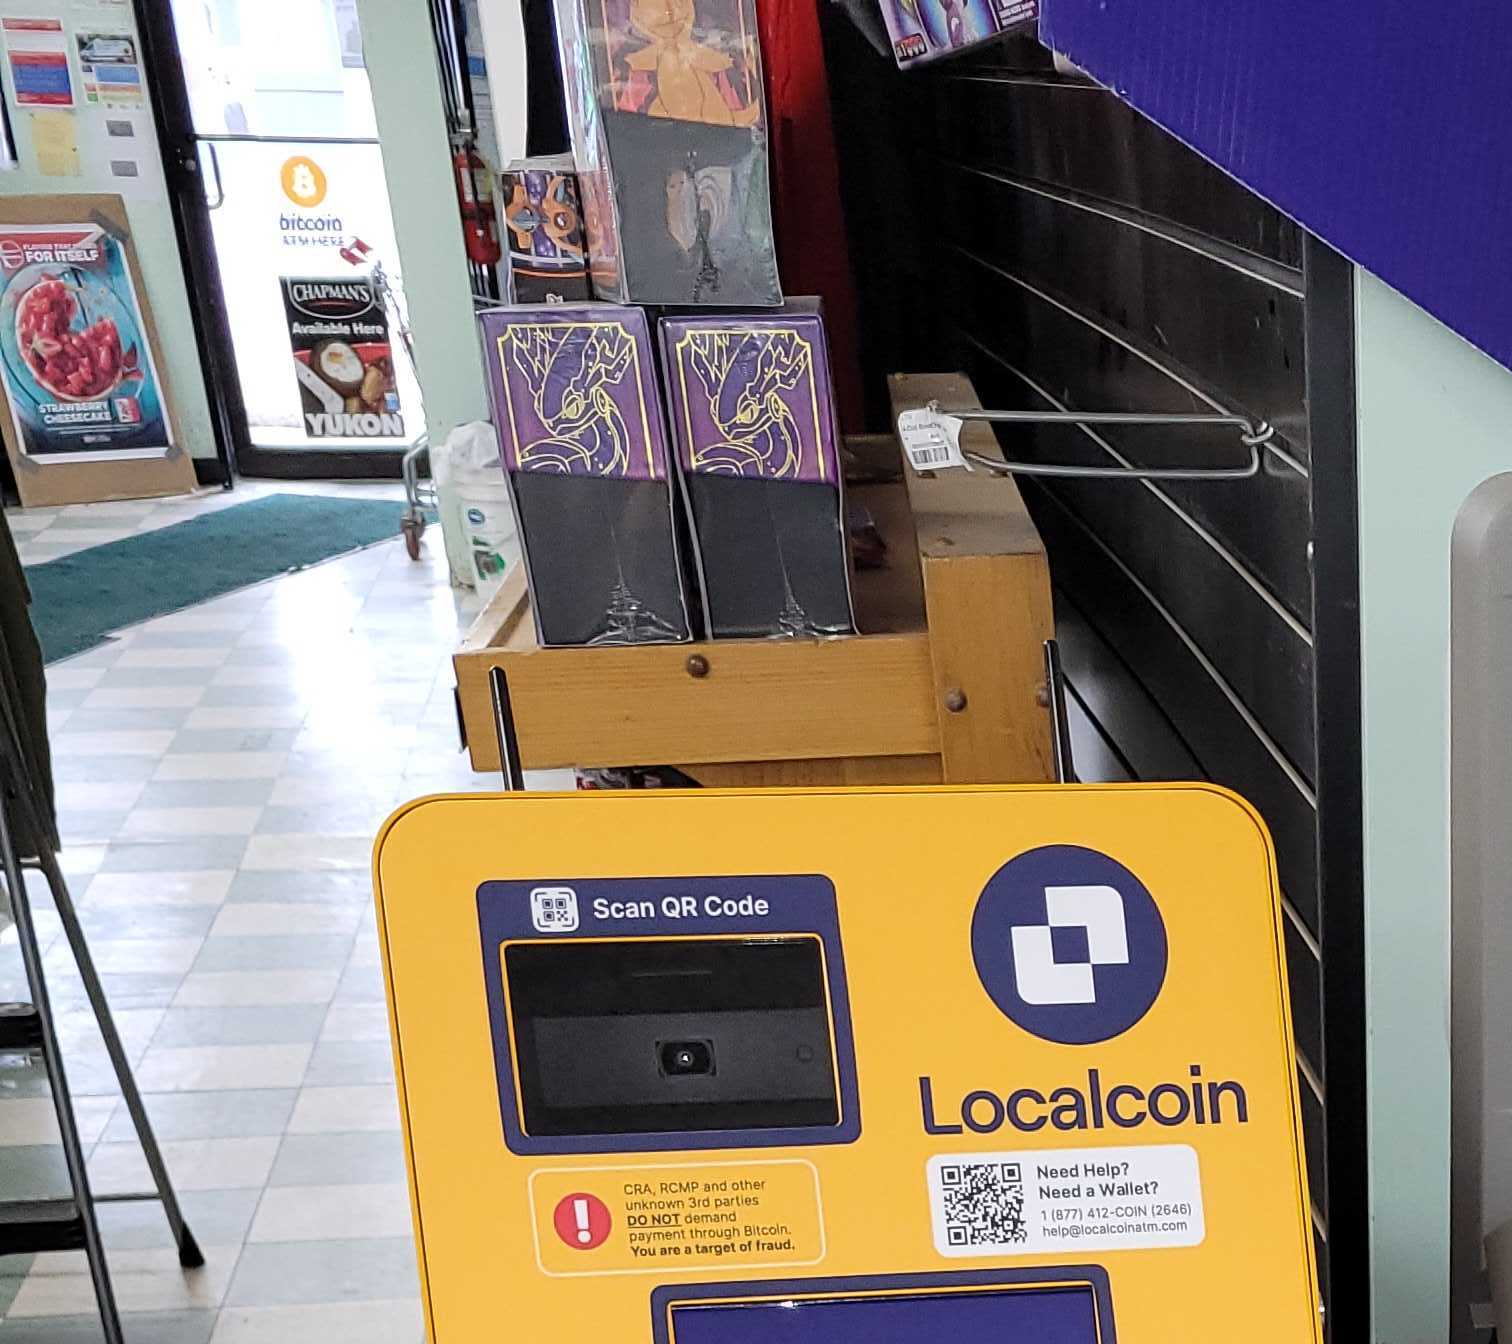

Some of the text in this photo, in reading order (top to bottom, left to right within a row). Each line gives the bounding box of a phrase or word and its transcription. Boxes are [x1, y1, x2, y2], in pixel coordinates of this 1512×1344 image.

[279, 213, 343, 232] bitcoin
[25, 249, 99, 263] FOR ITSELF
[292, 283, 370, 302] CHAPMAN'S
[292, 321, 385, 336] Available Here
[39, 401, 108, 414] STRAWBERRY
[43, 411, 112, 424] CHEESECAKE
[305, 412, 404, 437] YUKON
[592, 895, 769, 919] Scan QR Code
[919, 1064, 1248, 1135] Localcoin
[1037, 1162, 1129, 1180] Need Help?
[623, 1179, 765, 1196] CRA, RCMP and other
[1039, 1181, 1159, 1200] Need a Wallet?
[625, 1194, 759, 1211] unknown 3rd parties
[627, 1212, 736, 1226] DO NOT demand
[1051, 1208, 1083, 1222] (877)
[1087, 1205, 1147, 1219] 412-COIN
[1152, 1203, 1192, 1218] (2646)
[629, 1223, 792, 1244] payment through Bitcoin.
[1042, 1220, 1188, 1240] help@localcoinatm.com
[630, 1239, 795, 1257] You are a target of fraud.
